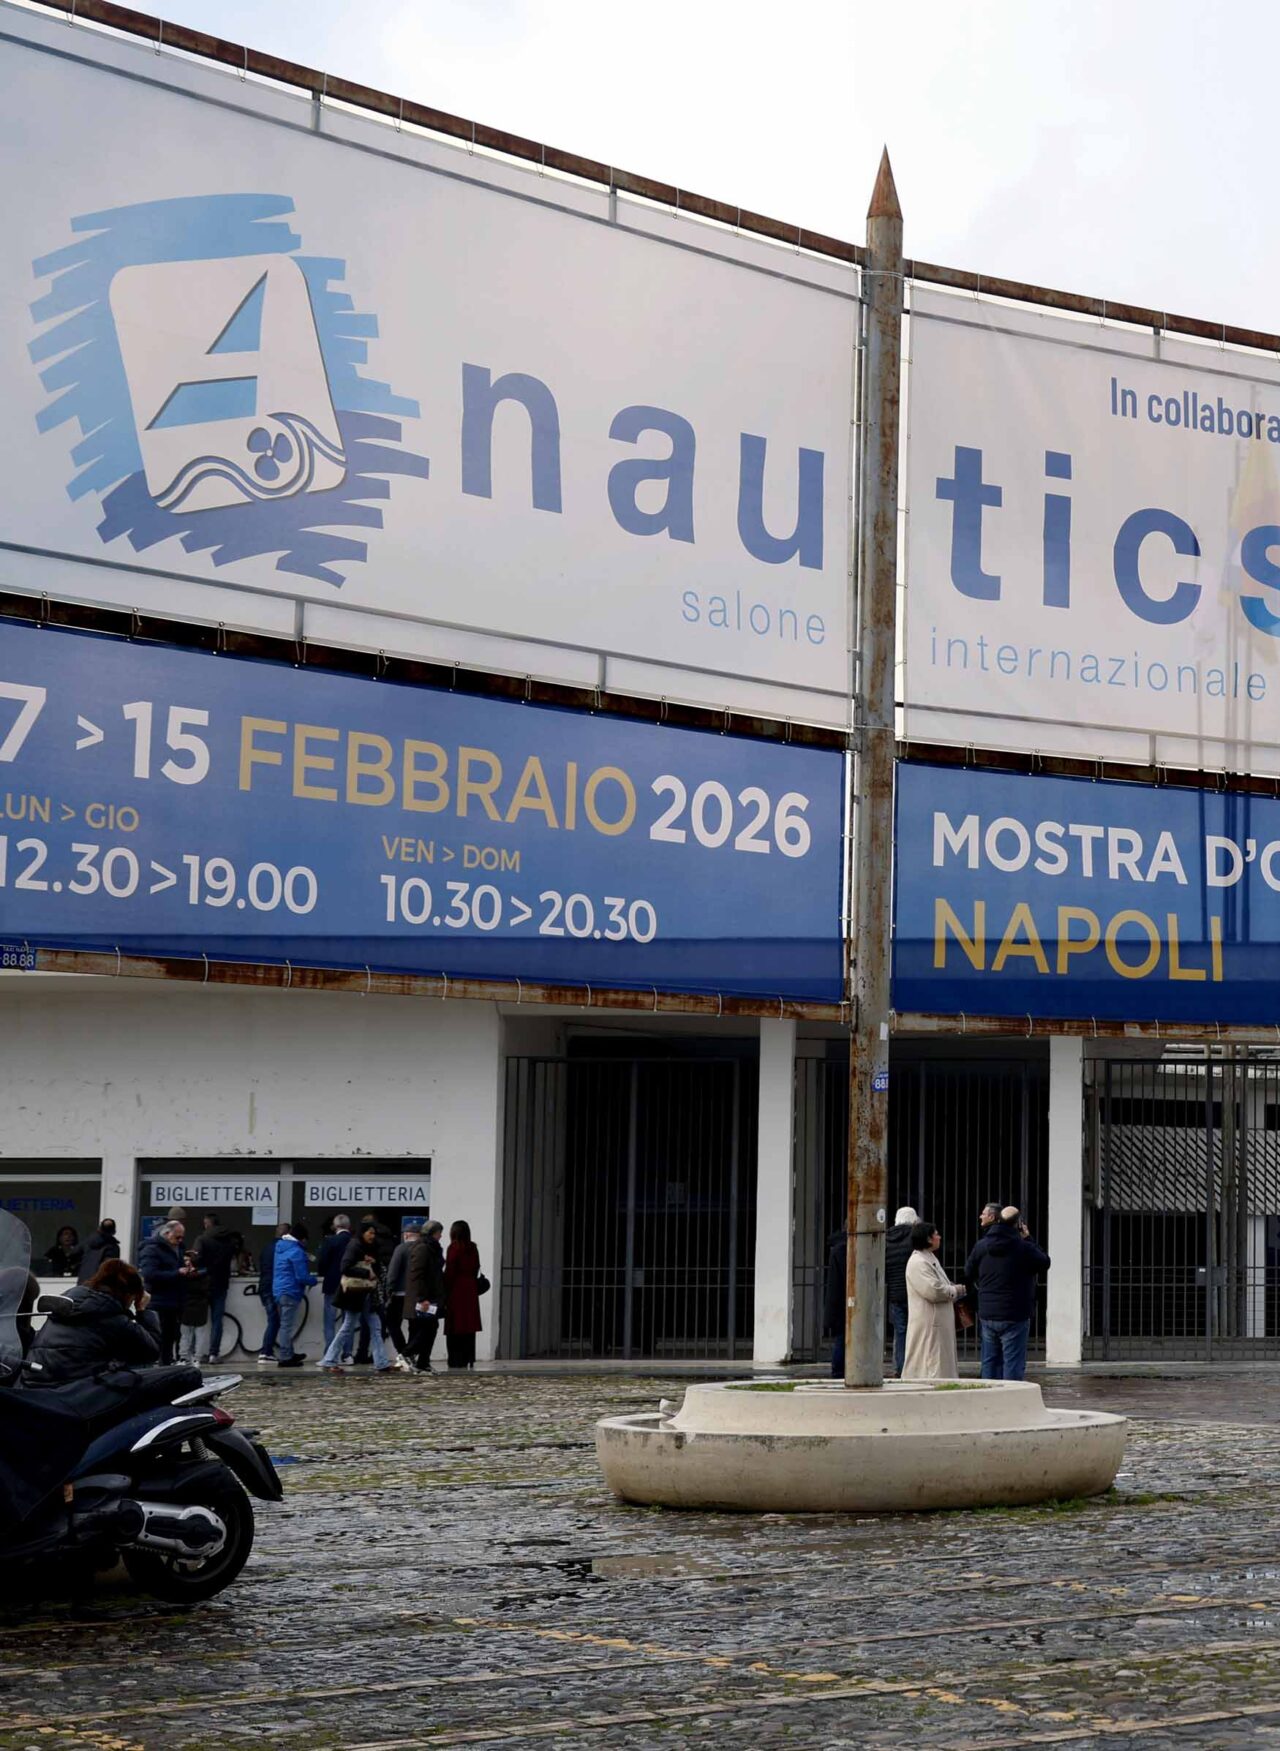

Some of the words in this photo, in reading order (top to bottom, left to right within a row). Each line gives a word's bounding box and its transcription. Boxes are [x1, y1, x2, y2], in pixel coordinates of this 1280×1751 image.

[1111, 377, 1138, 419] In
[681, 589, 826, 643] salone
[930, 627, 1266, 701] internazionale
[238, 715, 637, 836] FEBBRAIO
[649, 774, 812, 858] 2026
[84, 803, 140, 832] GIO
[381, 835, 435, 864] VEN
[462, 844, 521, 873] DOM
[933, 812, 1188, 885] MOSTRA
[933, 898, 1224, 981] NAPOLI
[156, 1186, 273, 1202] BIGLIETTERIA
[310, 1186, 426, 1202] BIGLIETTERIA
